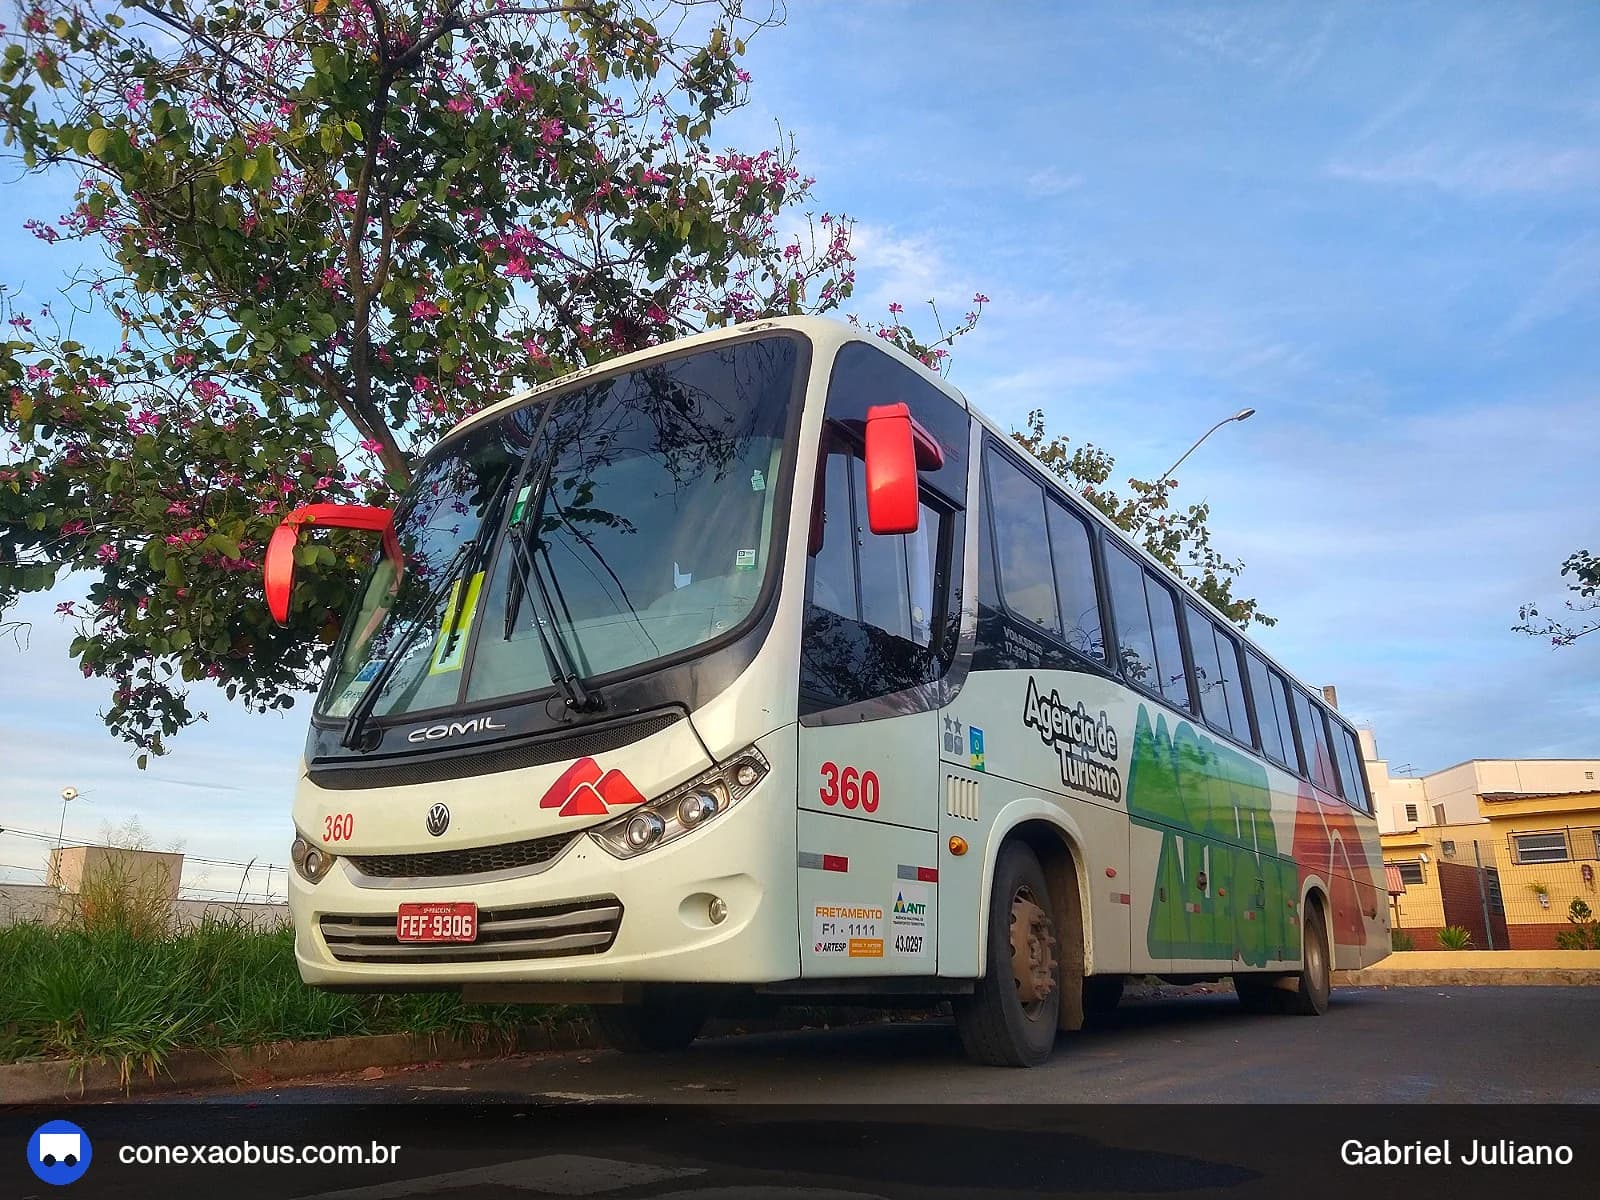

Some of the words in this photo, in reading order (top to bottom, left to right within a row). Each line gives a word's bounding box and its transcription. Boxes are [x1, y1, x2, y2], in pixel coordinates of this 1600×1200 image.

[1024, 675, 1098, 752] Agência
[1096, 709, 1118, 762] de
[408, 717, 506, 743] COMIL
[1054, 739, 1122, 804] Turismo
[819, 761, 881, 814] 360
[322, 812, 354, 843] 360
[815, 906, 883, 920] FRETAMENTO
[906, 902, 926, 915] ANTT
[822, 923, 836, 936] F1
[848, 923, 876, 936] 1111
[822, 942, 847, 953] ARTESP
[895, 934, 923, 953] 43.0297
